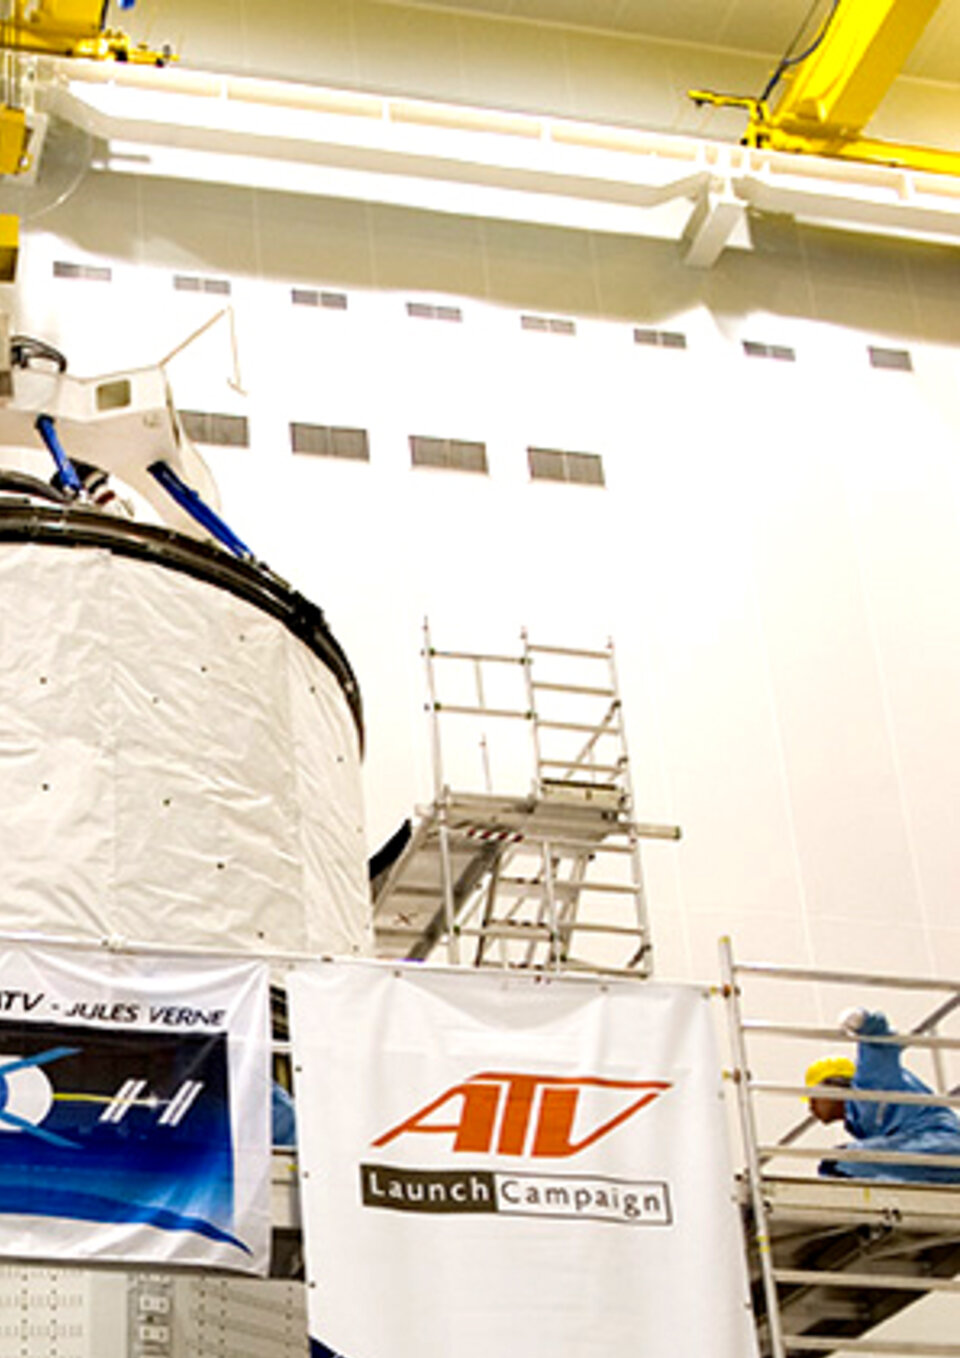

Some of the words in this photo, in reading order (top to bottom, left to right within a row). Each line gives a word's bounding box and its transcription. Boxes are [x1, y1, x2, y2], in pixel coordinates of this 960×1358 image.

[64, 1000, 139, 1023] JULES
[147, 1007, 228, 1028] VERNE
[370, 1071, 674, 1159] ATV
[369, 1171, 492, 1203] Launch
[501, 1179, 662, 1218] Campaign
